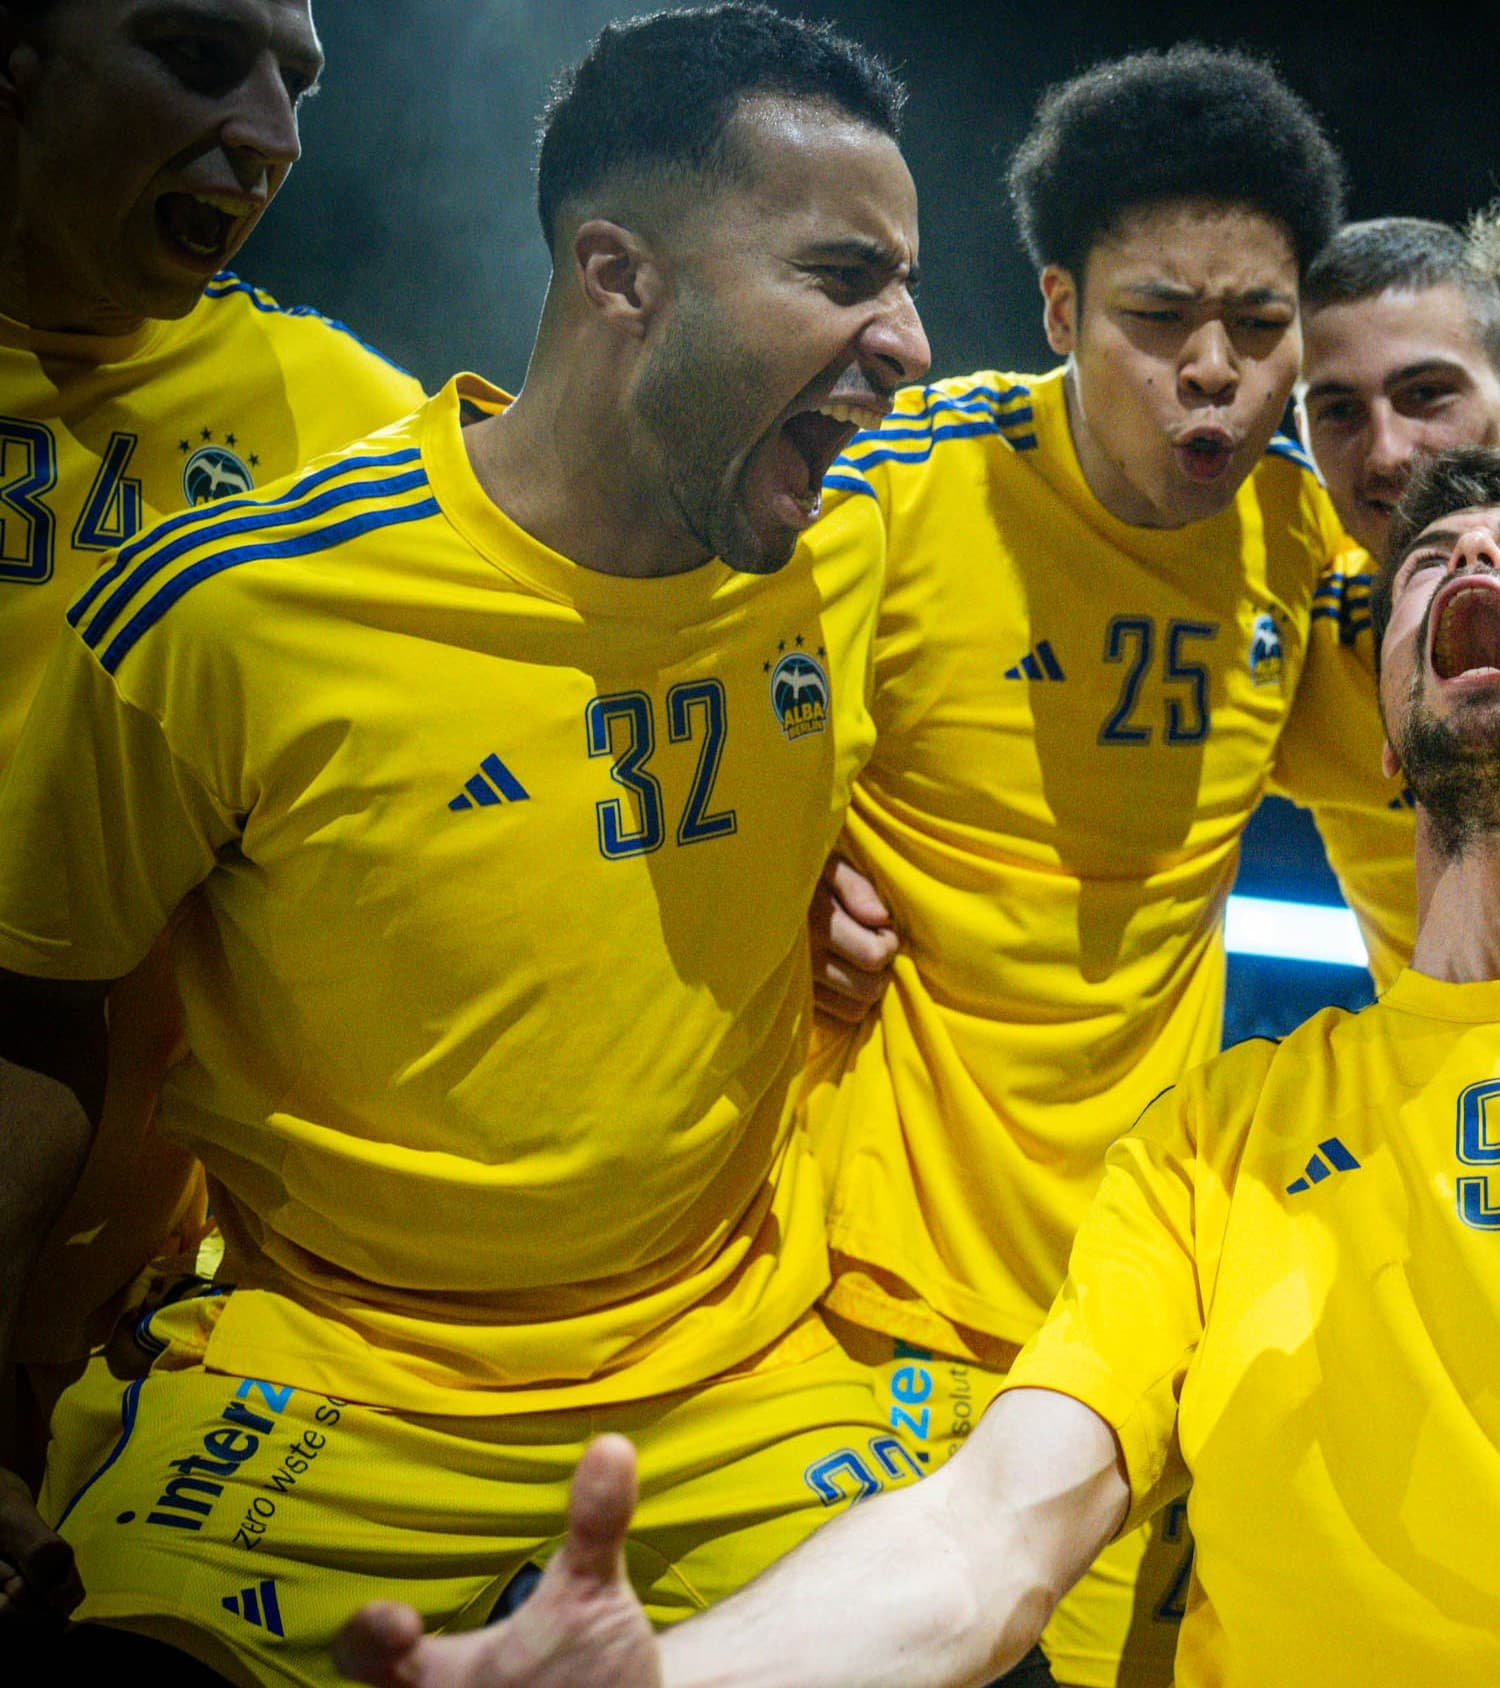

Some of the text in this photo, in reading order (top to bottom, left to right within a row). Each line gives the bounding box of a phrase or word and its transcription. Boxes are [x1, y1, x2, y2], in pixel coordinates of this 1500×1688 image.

[0, 415, 142, 584] 34
[784, 701, 825, 728] ALBA
[1096, 614, 1220, 746] 25
[585, 677, 737, 860] 32
[232, 1497, 276, 1551] zero
